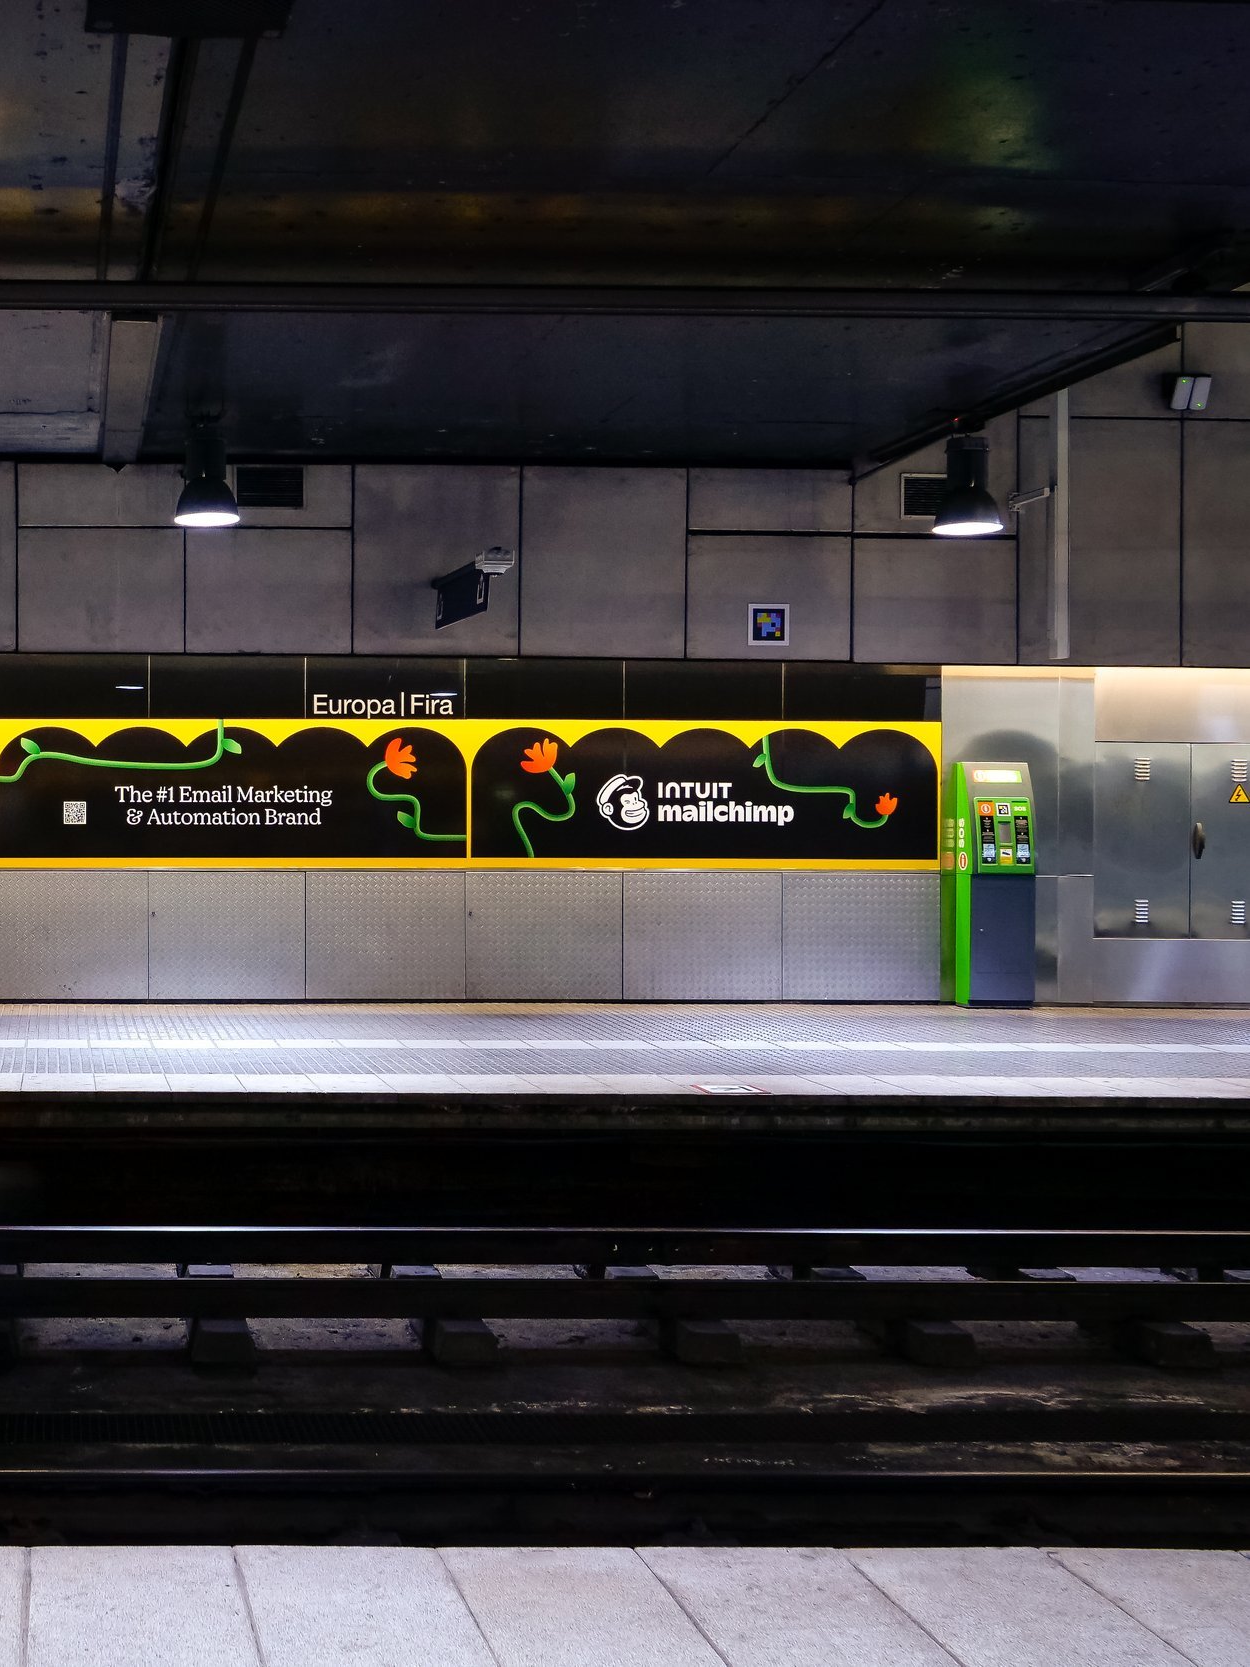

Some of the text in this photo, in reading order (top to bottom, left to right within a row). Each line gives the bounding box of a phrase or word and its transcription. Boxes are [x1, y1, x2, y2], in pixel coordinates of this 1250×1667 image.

[313, 694, 396, 719] Europa
[410, 694, 453, 714] Fira
[115, 785, 333, 807] The #1 Email Marketing
[657, 782, 733, 798] INTUIT
[126, 807, 322, 825] & Automation Brand
[657, 801, 795, 826] mailchimp
